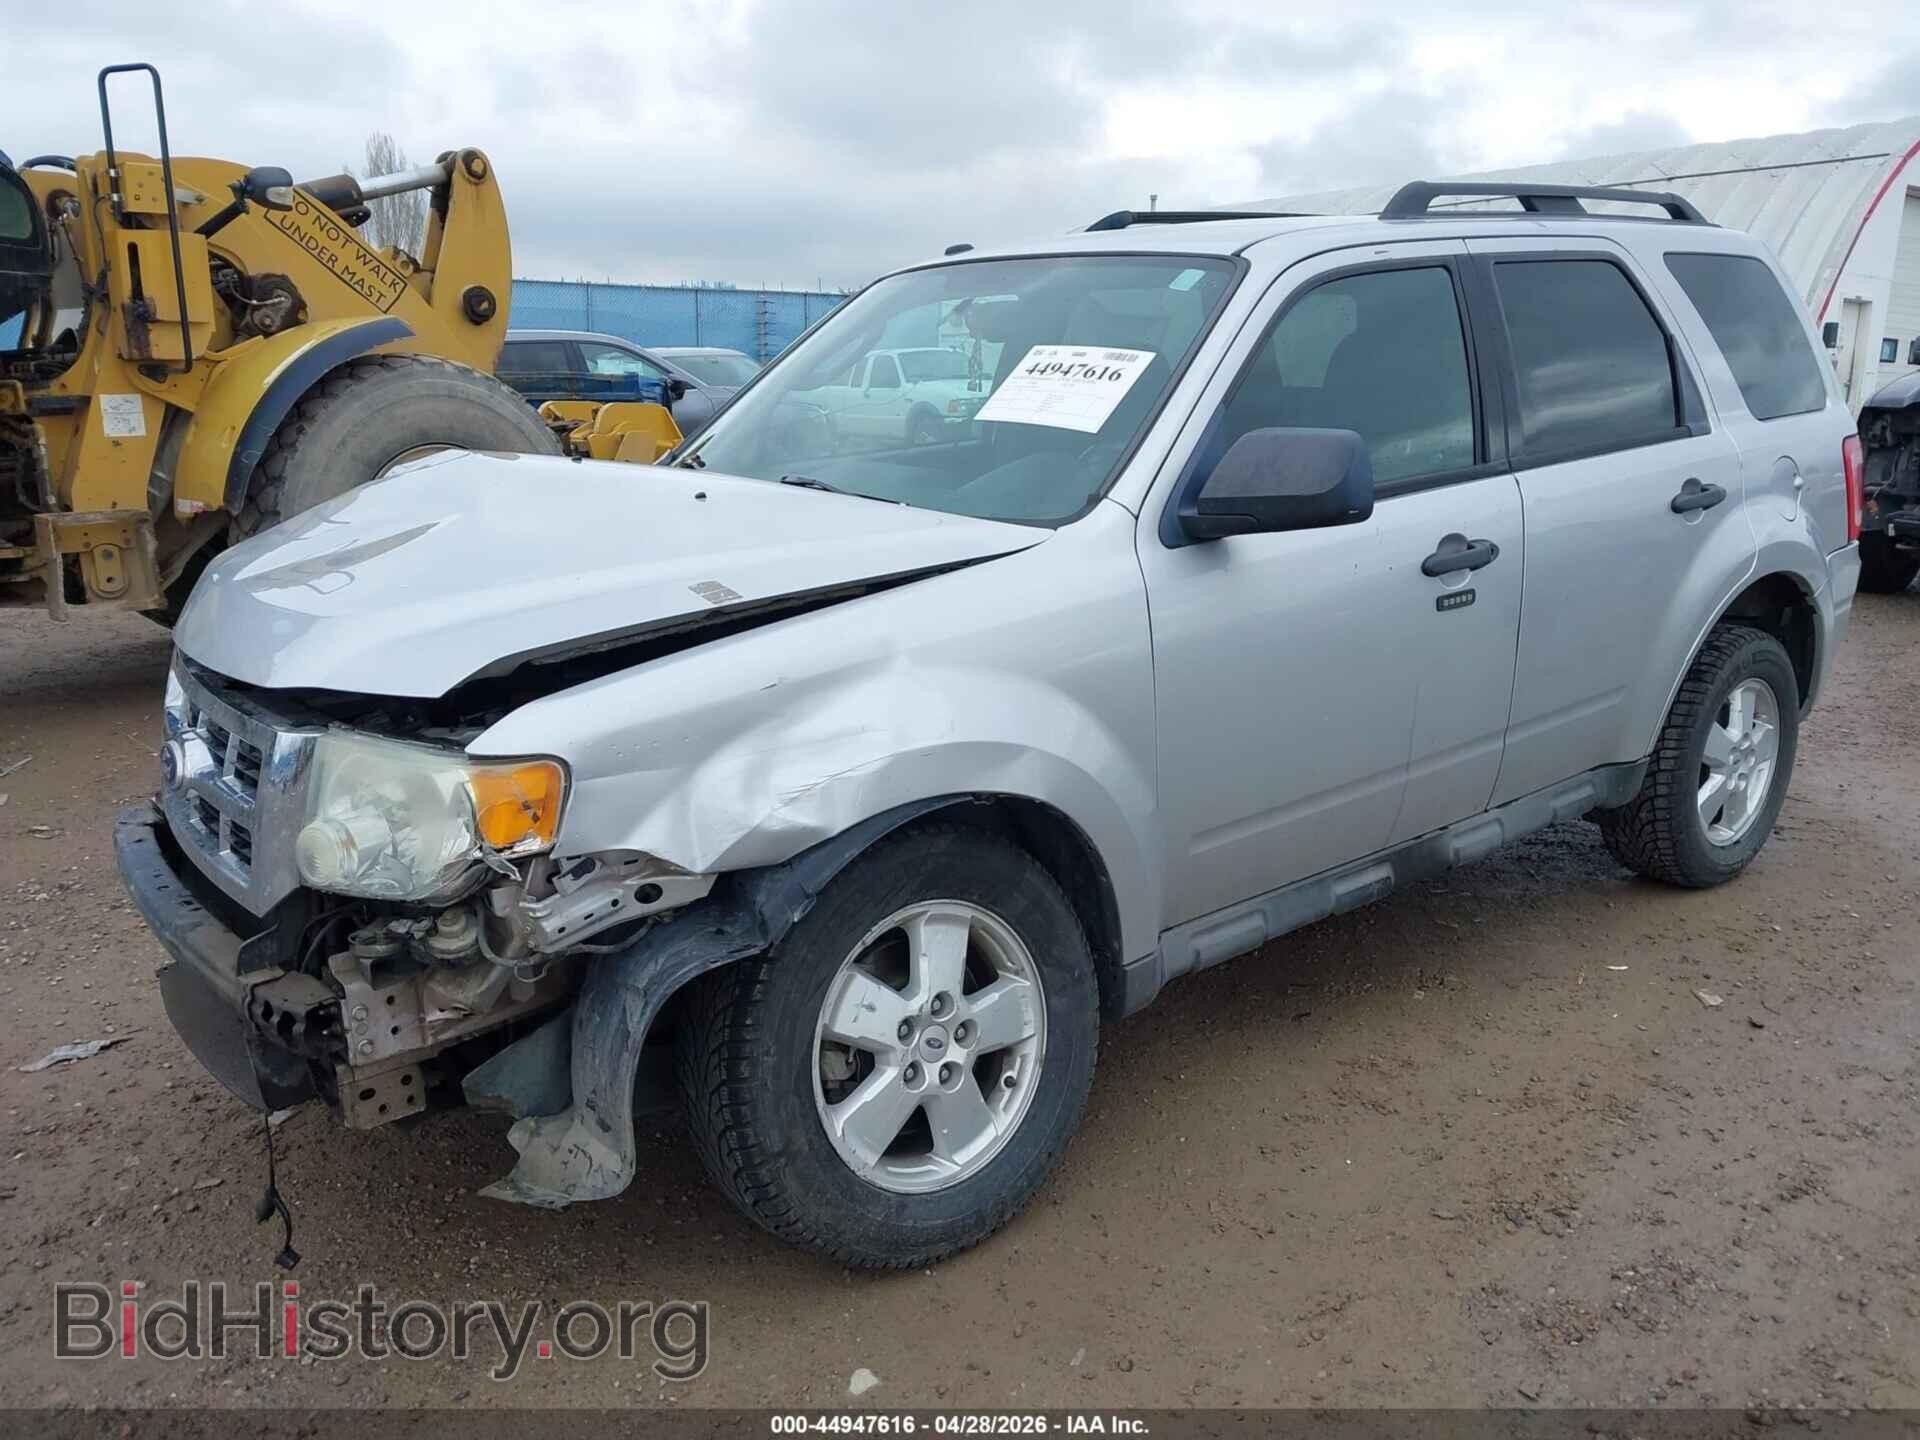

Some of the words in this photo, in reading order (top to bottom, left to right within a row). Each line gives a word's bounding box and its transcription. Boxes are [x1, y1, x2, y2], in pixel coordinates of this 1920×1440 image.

[280, 214, 339, 268] UNDER
[340, 265, 387, 304] MAST
[312, 215, 353, 249] NOT
[355, 247, 400, 293] WALK
[1025, 362, 1126, 382] 44947616
